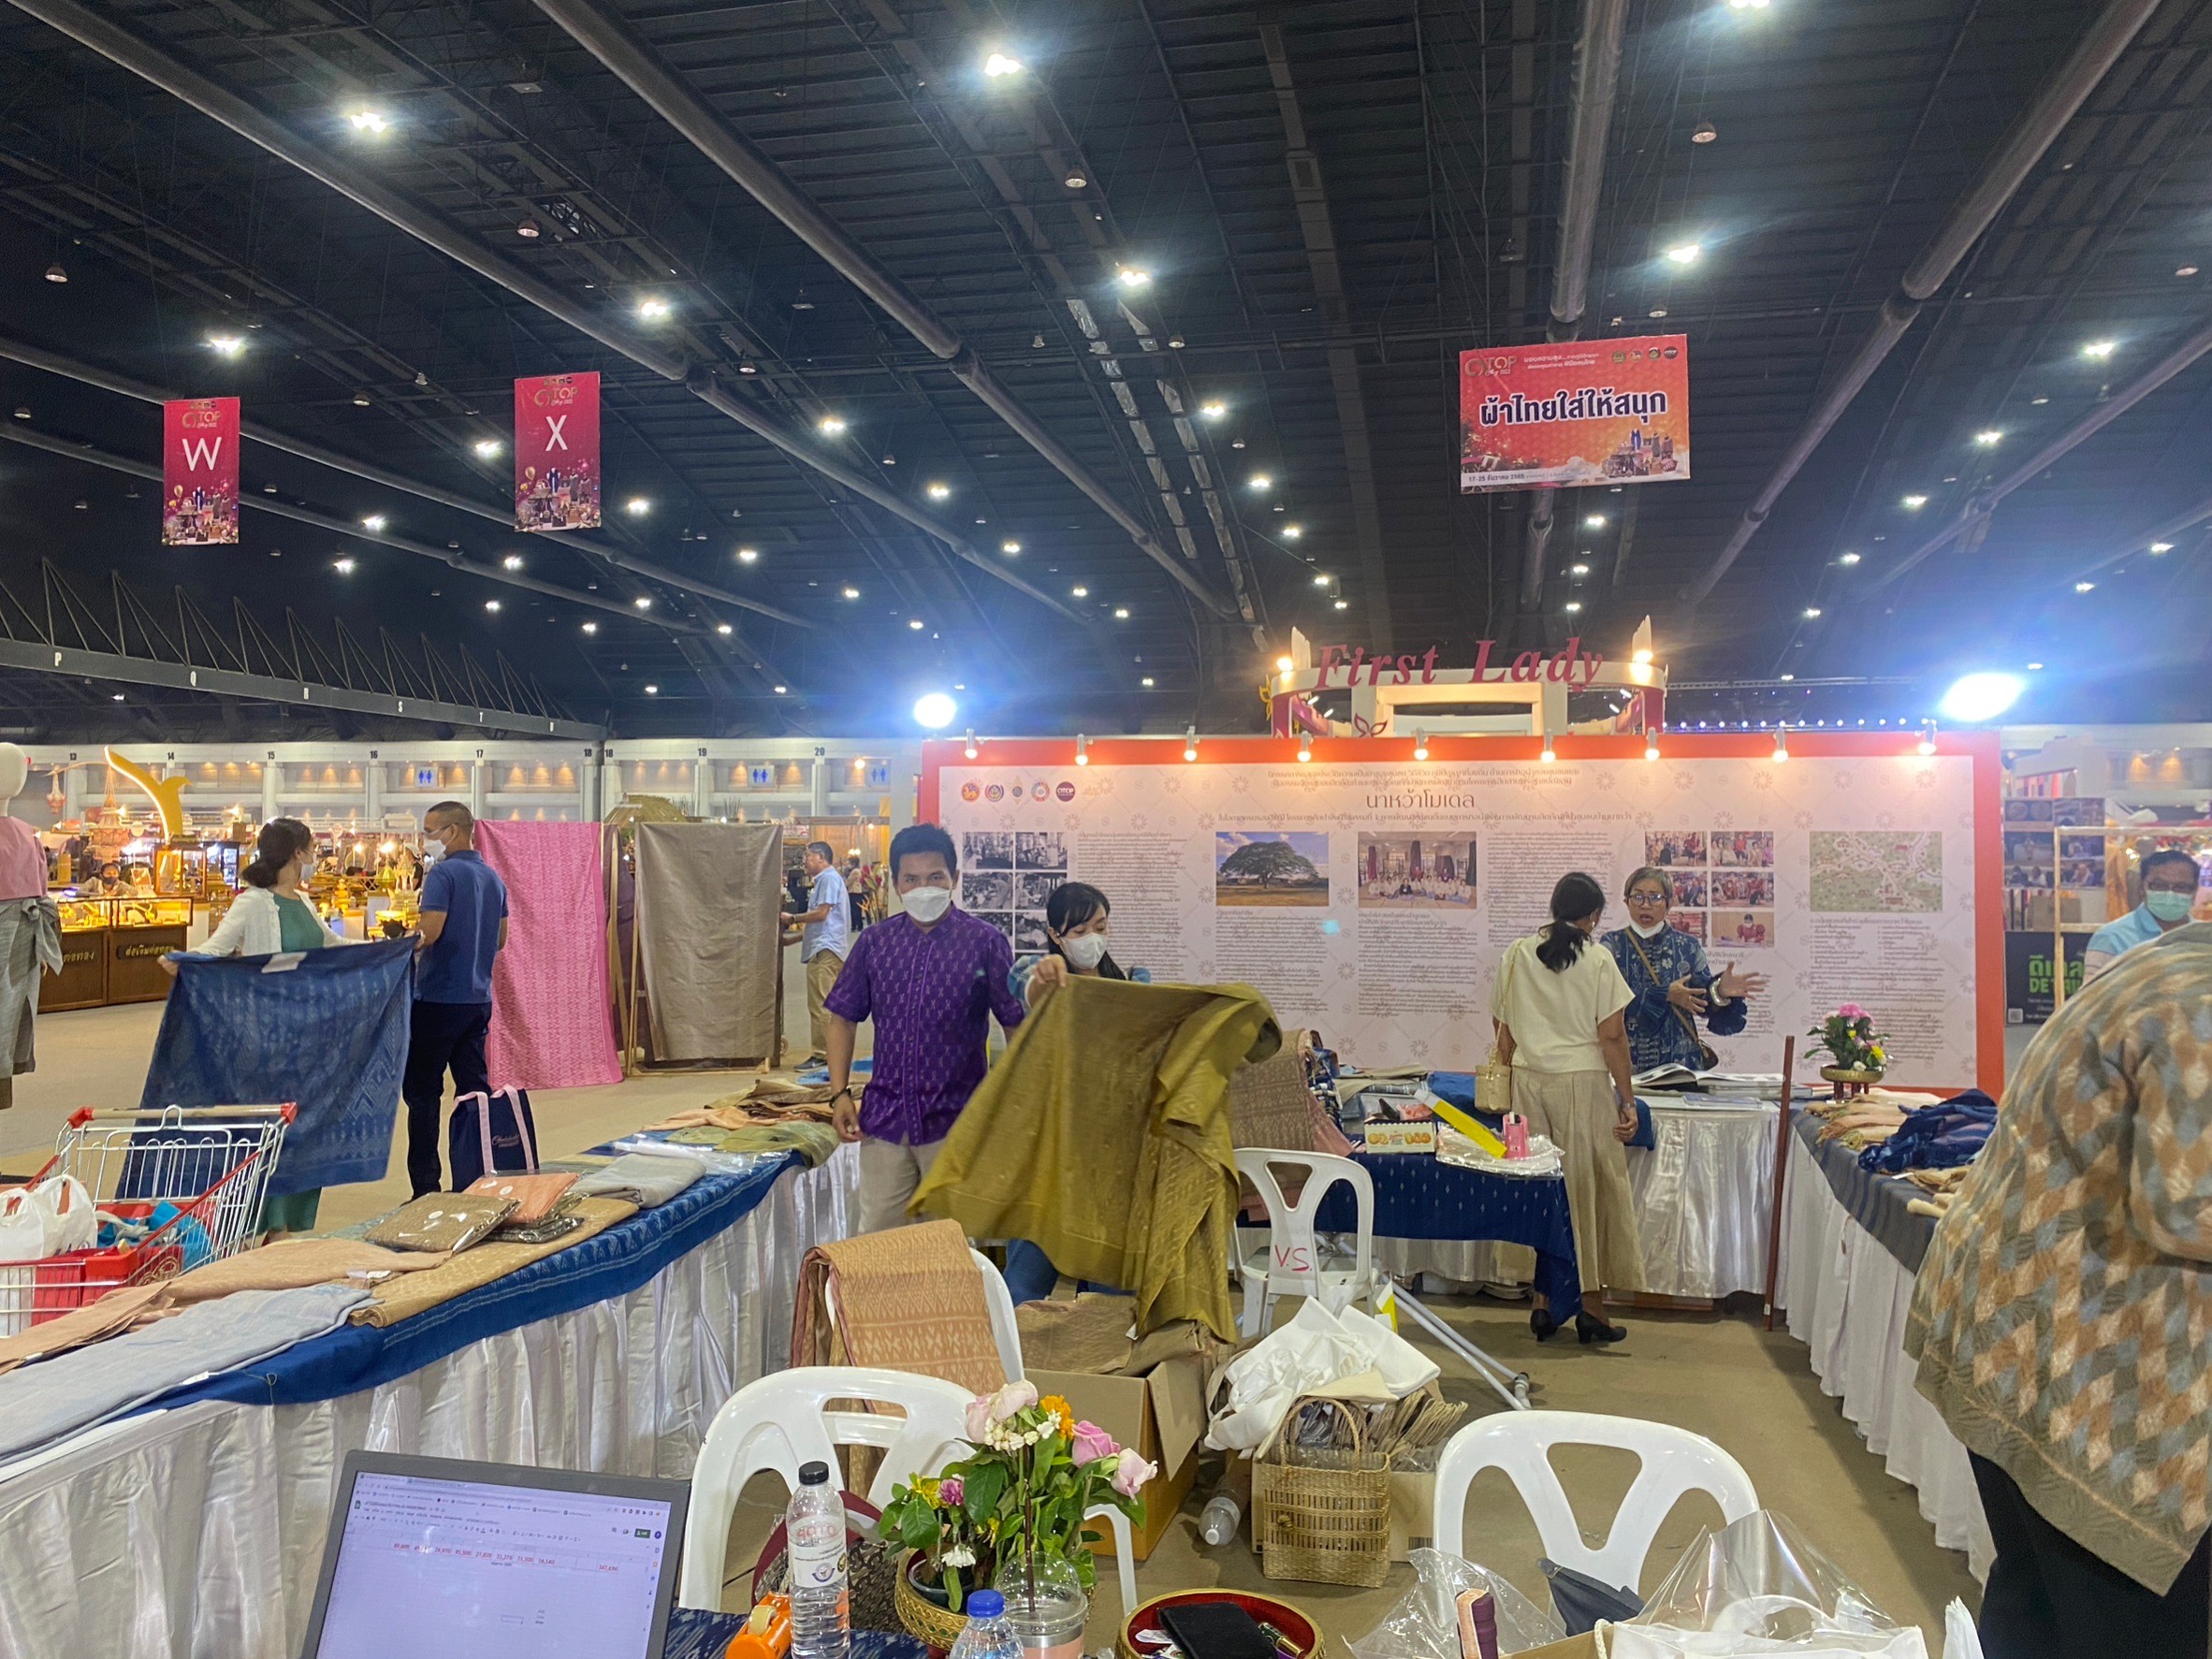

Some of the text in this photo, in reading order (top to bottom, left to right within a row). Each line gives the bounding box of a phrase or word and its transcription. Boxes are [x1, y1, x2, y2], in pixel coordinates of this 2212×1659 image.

[1480, 389, 1666, 424] ผ้าไทยใส่ให้สนุก
[545, 415, 568, 452] X
[182, 437, 222, 472] W
[54, 651, 62, 666] P
[1314, 636, 1604, 691] First Lady
[190, 671, 197, 687] Q
[398, 701, 403, 712] S
[479, 712, 484, 722] T
[167, 752, 175, 761] 14
[268, 750, 275, 760] 15
[370, 749, 378, 760] 16
[476, 749, 484, 759] 17
[584, 749, 592, 758] 18
[604, 749, 613, 758] 18
[698, 748, 707, 757] 19
[815, 747, 825, 756] 20
[1367, 789, 1476, 808] นาหว้าโมเดล
[2029, 955, 2084, 977] ดีเล
